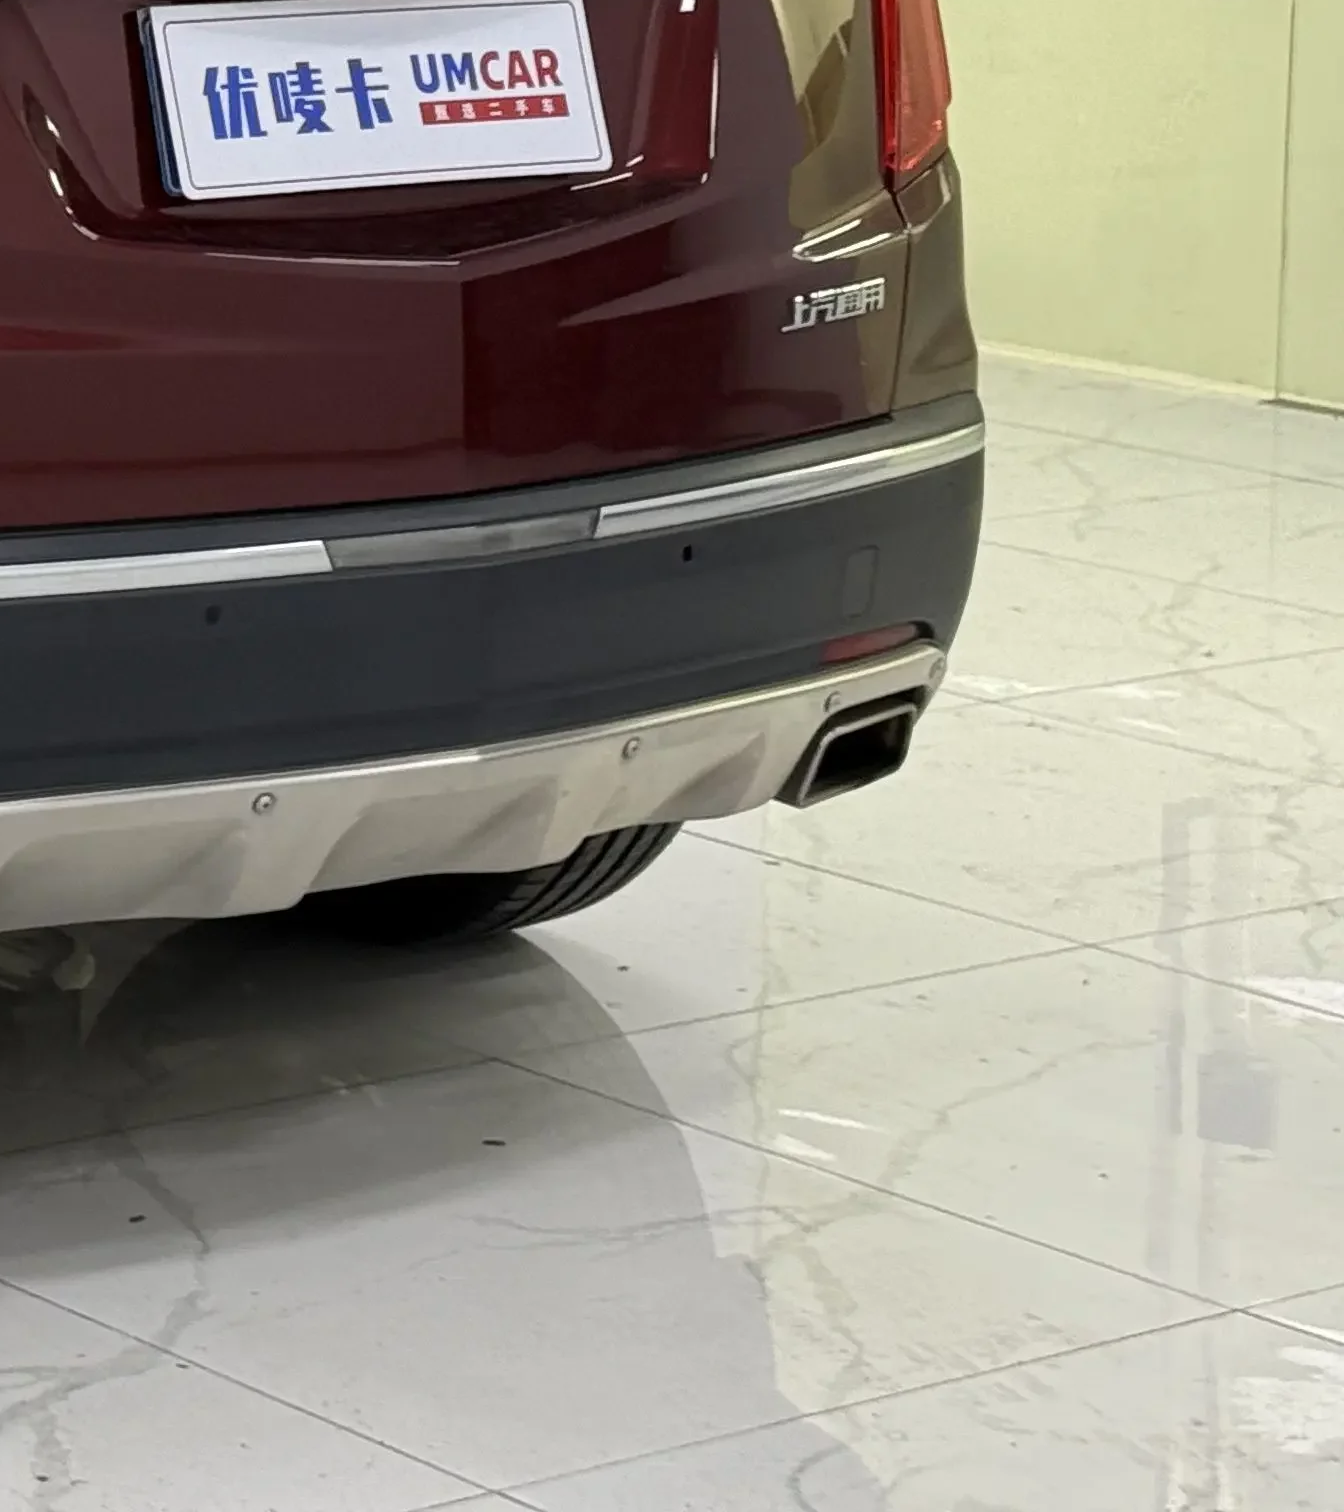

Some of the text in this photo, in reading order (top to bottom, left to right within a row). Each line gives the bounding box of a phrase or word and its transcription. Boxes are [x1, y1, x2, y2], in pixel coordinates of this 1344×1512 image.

[202, 58, 394, 140] 优唛卡
[409, 47, 563, 93] UMCAR
[779, 276, 886, 334] 上汽通用
